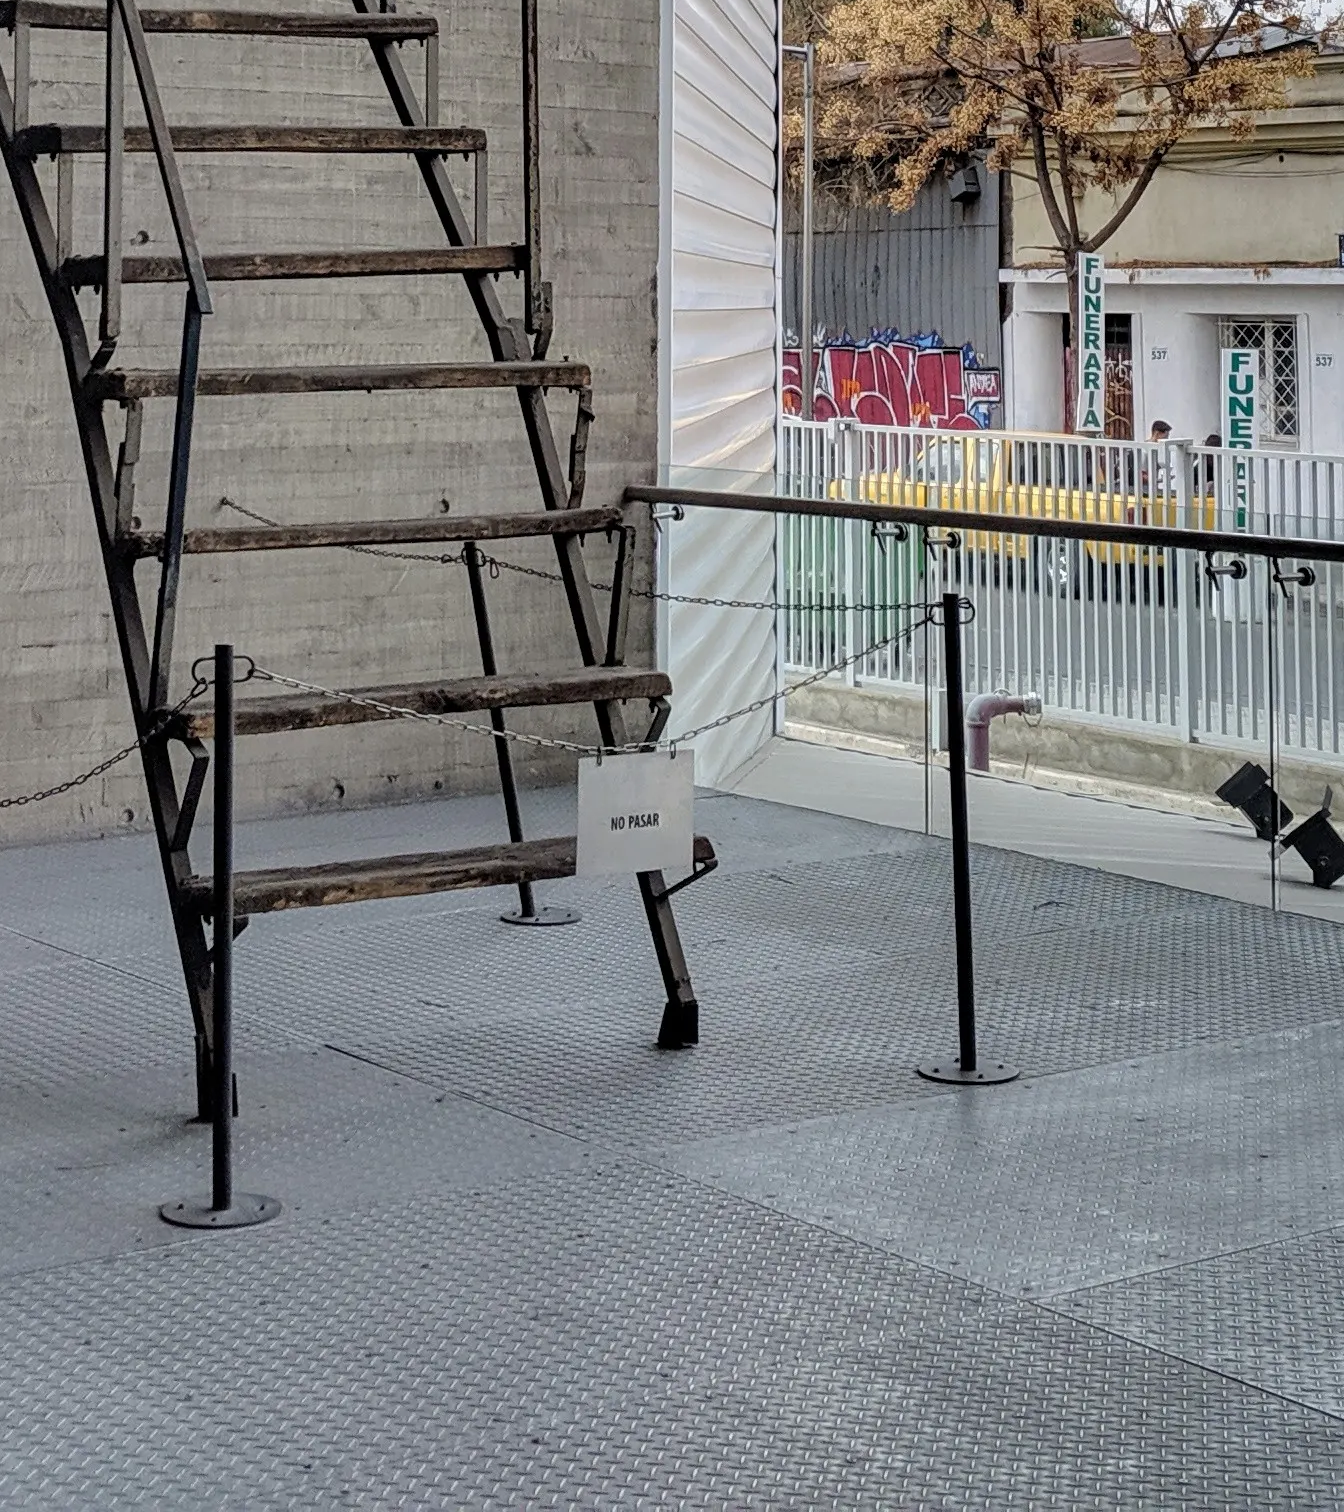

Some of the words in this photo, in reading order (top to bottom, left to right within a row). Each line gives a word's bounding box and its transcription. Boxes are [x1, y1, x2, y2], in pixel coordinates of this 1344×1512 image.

[1083, 256, 1102, 428] FUNERARIA
[611, 816, 625, 831] NO
[628, 813, 660, 829] PASAR
